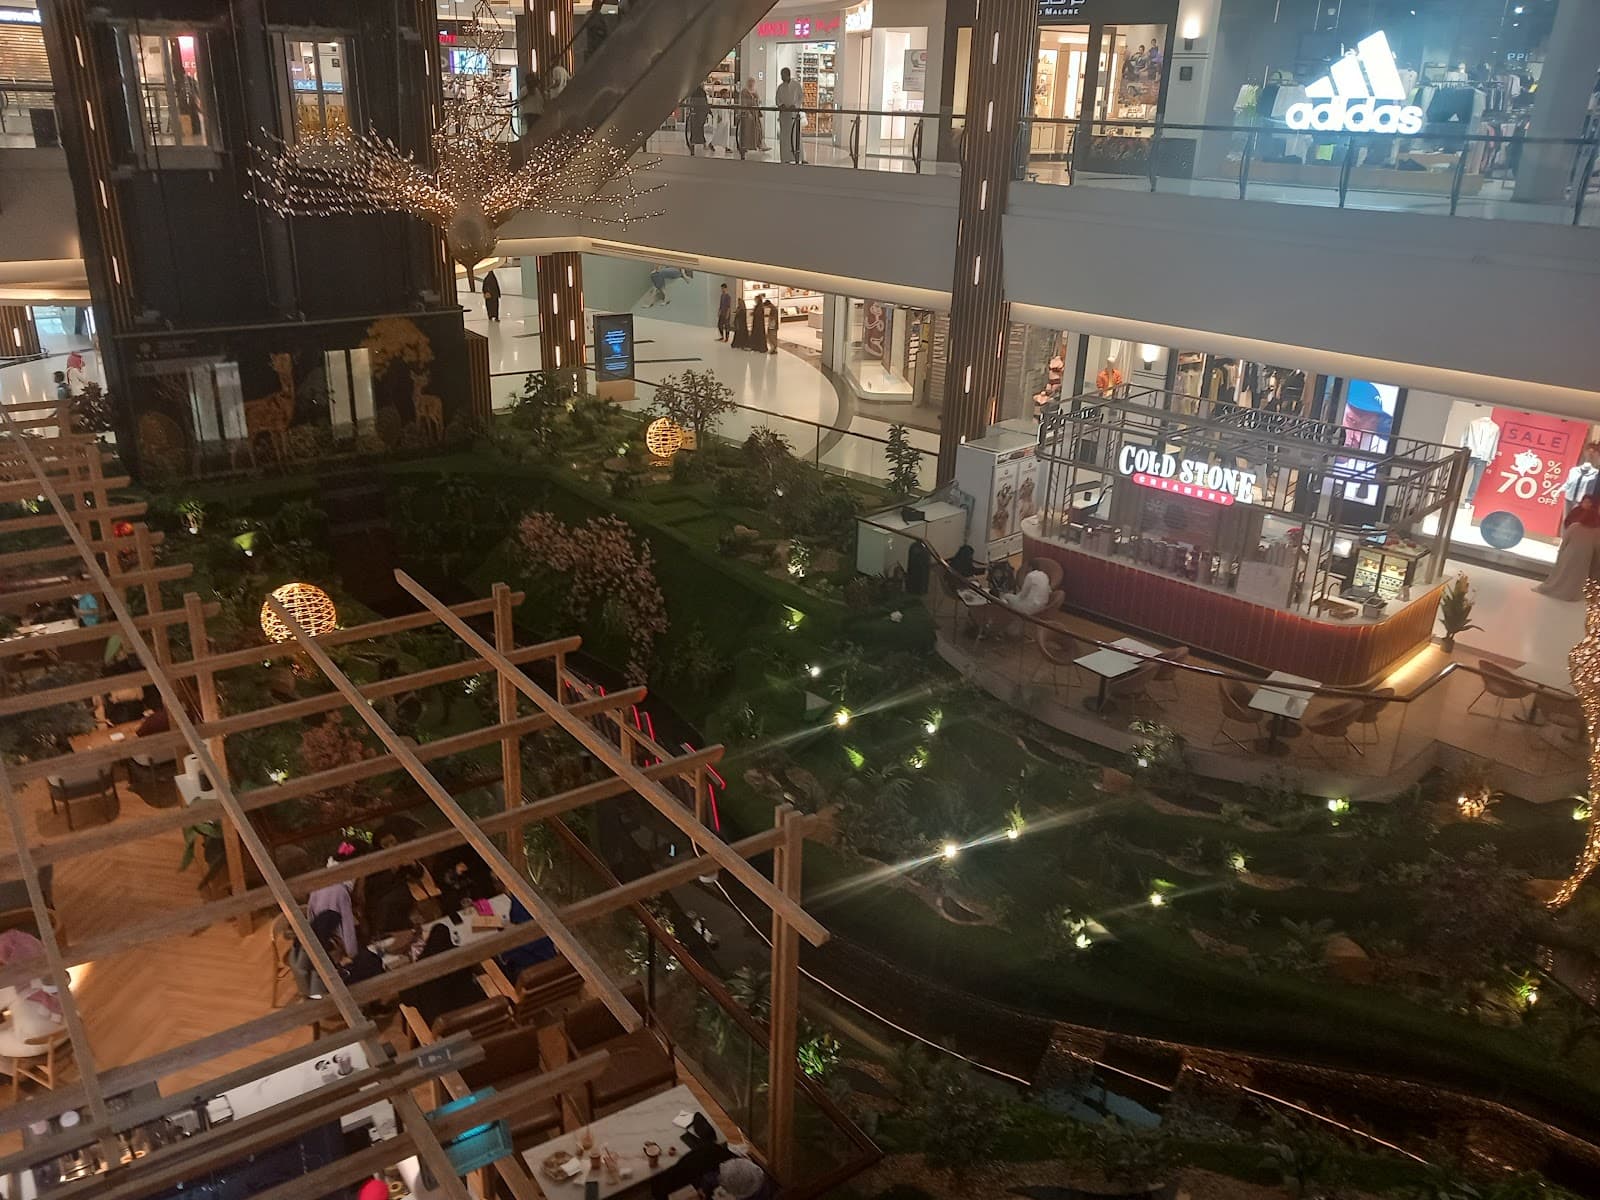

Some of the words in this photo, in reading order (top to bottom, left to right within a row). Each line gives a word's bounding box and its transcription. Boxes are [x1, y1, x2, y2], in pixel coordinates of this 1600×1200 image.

[1285, 95, 1424, 134] adidas
[1507, 428, 1563, 448] SALE
[1119, 445, 1176, 478] COLD
[1180, 459, 1256, 504] STONE
[1138, 476, 1228, 504] CREAMERY
